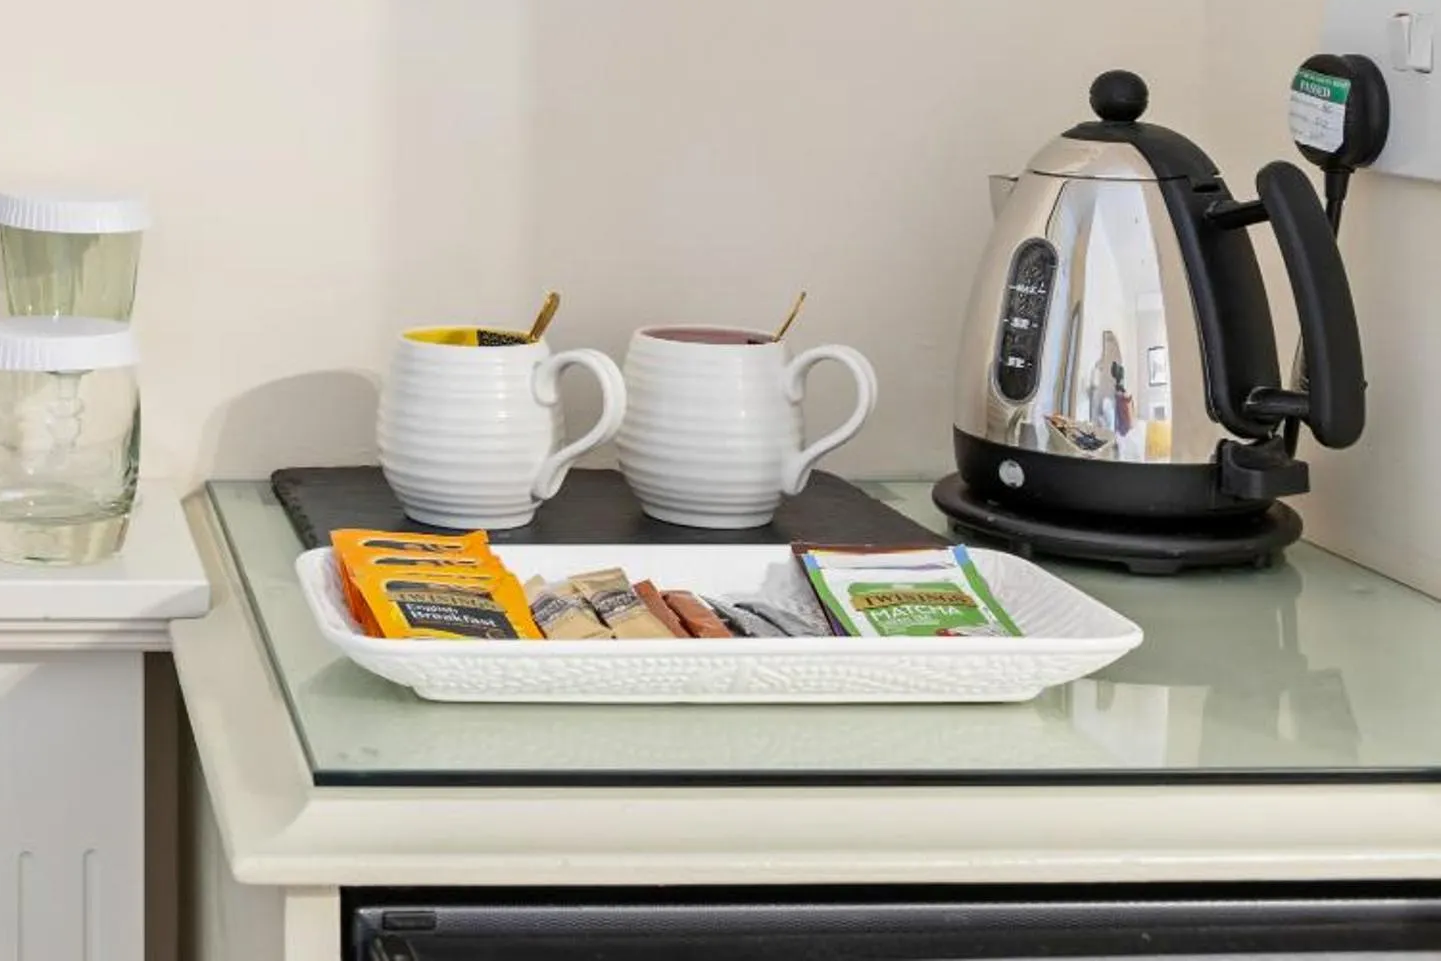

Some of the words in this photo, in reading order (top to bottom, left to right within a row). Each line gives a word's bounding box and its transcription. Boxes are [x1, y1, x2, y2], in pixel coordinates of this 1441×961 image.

[406, 602, 458, 614] English
[870, 605, 961, 621] MATCHA
[410, 611, 497, 627] Breakfast
